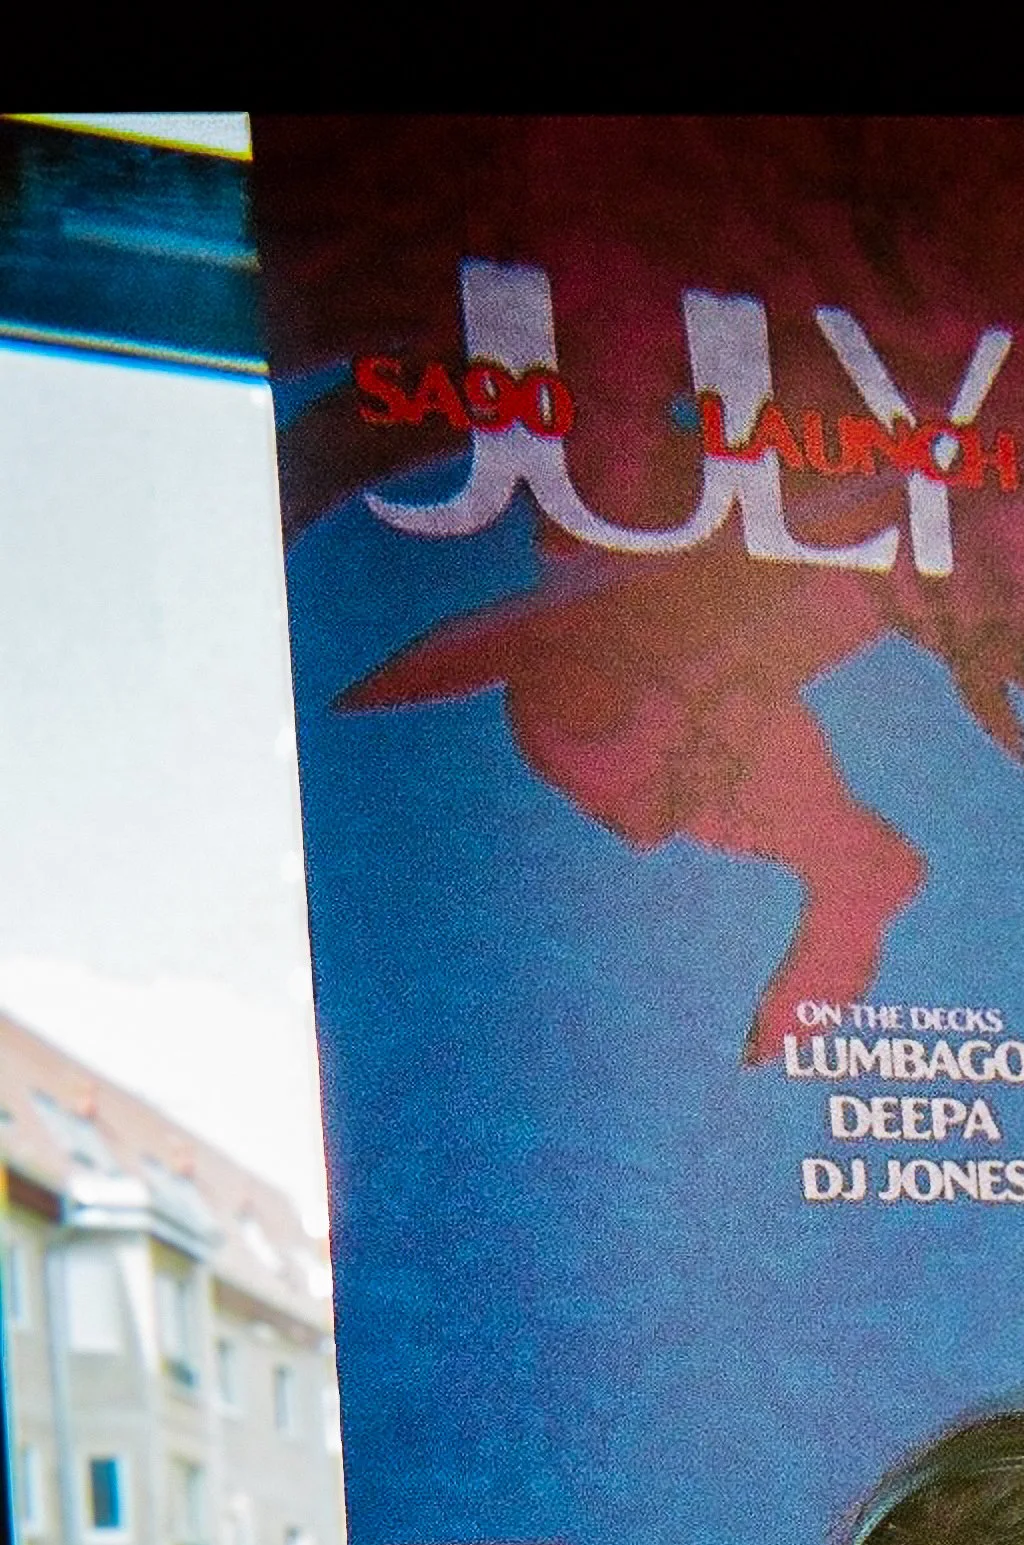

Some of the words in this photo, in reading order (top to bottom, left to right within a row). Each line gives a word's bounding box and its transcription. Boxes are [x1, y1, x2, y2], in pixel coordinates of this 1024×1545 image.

[355, 356, 575, 441] SA90
[702, 396, 1018, 492] LAUNCH
[364, 258, 1012, 575] JULY
[796, 1001, 842, 1027] ON
[850, 1004, 902, 1030] THE
[909, 1006, 1004, 1033] DECKS
[829, 1094, 1001, 1140] DEEPA
[801, 1158, 867, 1201] DJ
